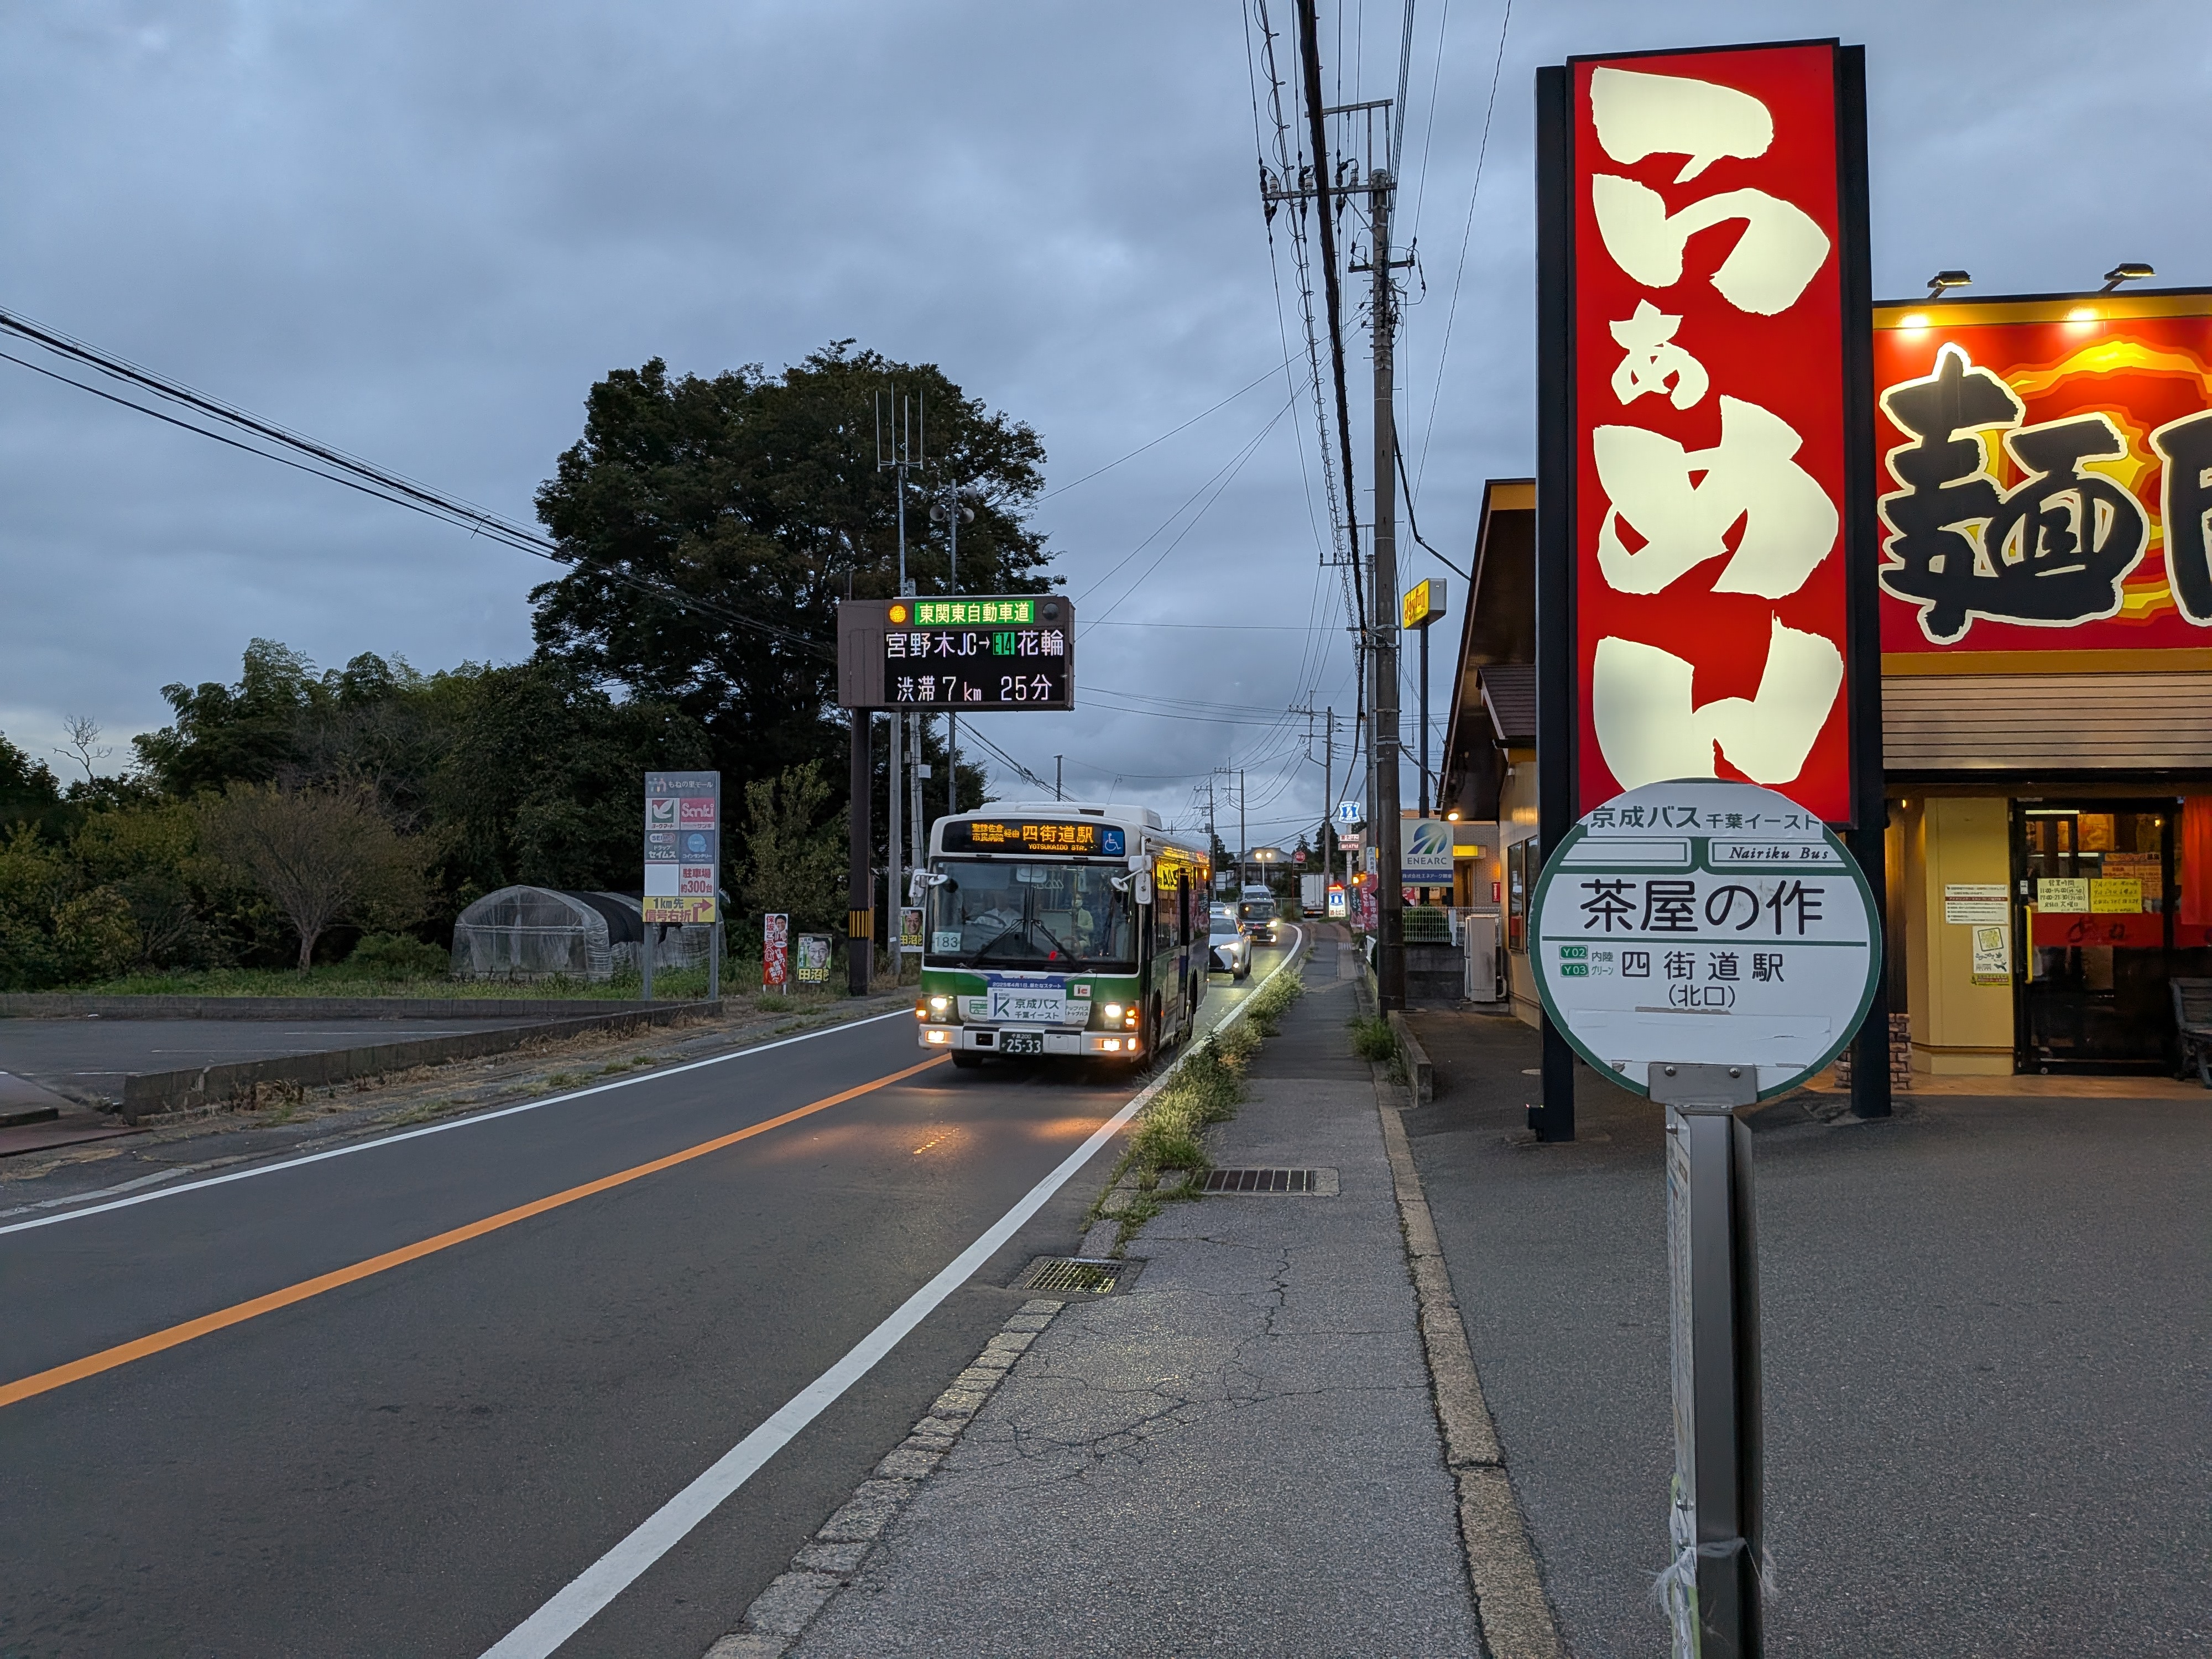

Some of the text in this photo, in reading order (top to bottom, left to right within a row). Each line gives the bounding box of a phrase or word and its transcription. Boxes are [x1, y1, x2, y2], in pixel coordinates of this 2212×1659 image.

[1590, 66, 1843, 791] らぁめん
[920, 603, 1029, 623] 東関東自動車道
[886, 632, 977, 658] 宮野木JC
[1017, 630, 1064, 656] 花輪
[1001, 674, 1052, 701] 25分
[682, 803, 714, 817] Sanki
[1590, 806, 1820, 830] 京成バス 千葉イースト
[1023, 825, 1093, 843] 四街道駅
[1729, 846, 1829, 859] Nairiku Bus
[682, 868, 711, 878] 駐車場
[681, 880, 712, 893] 約300台
[654, 898, 684, 909] 1km先
[1580, 879, 1825, 935] 茶屋の作
[645, 909, 691, 922] 信号右折
[935, 936, 958, 948] 183
[1592, 951, 1614, 962] 内陸
[1564, 966, 1587, 974] Y03
[1591, 966, 1614, 975] グリーン
[1621, 950, 1784, 982] 四街道駅
[1668, 984, 1735, 1008] (北口)
[1015, 999, 1059, 1009] 京成バス
